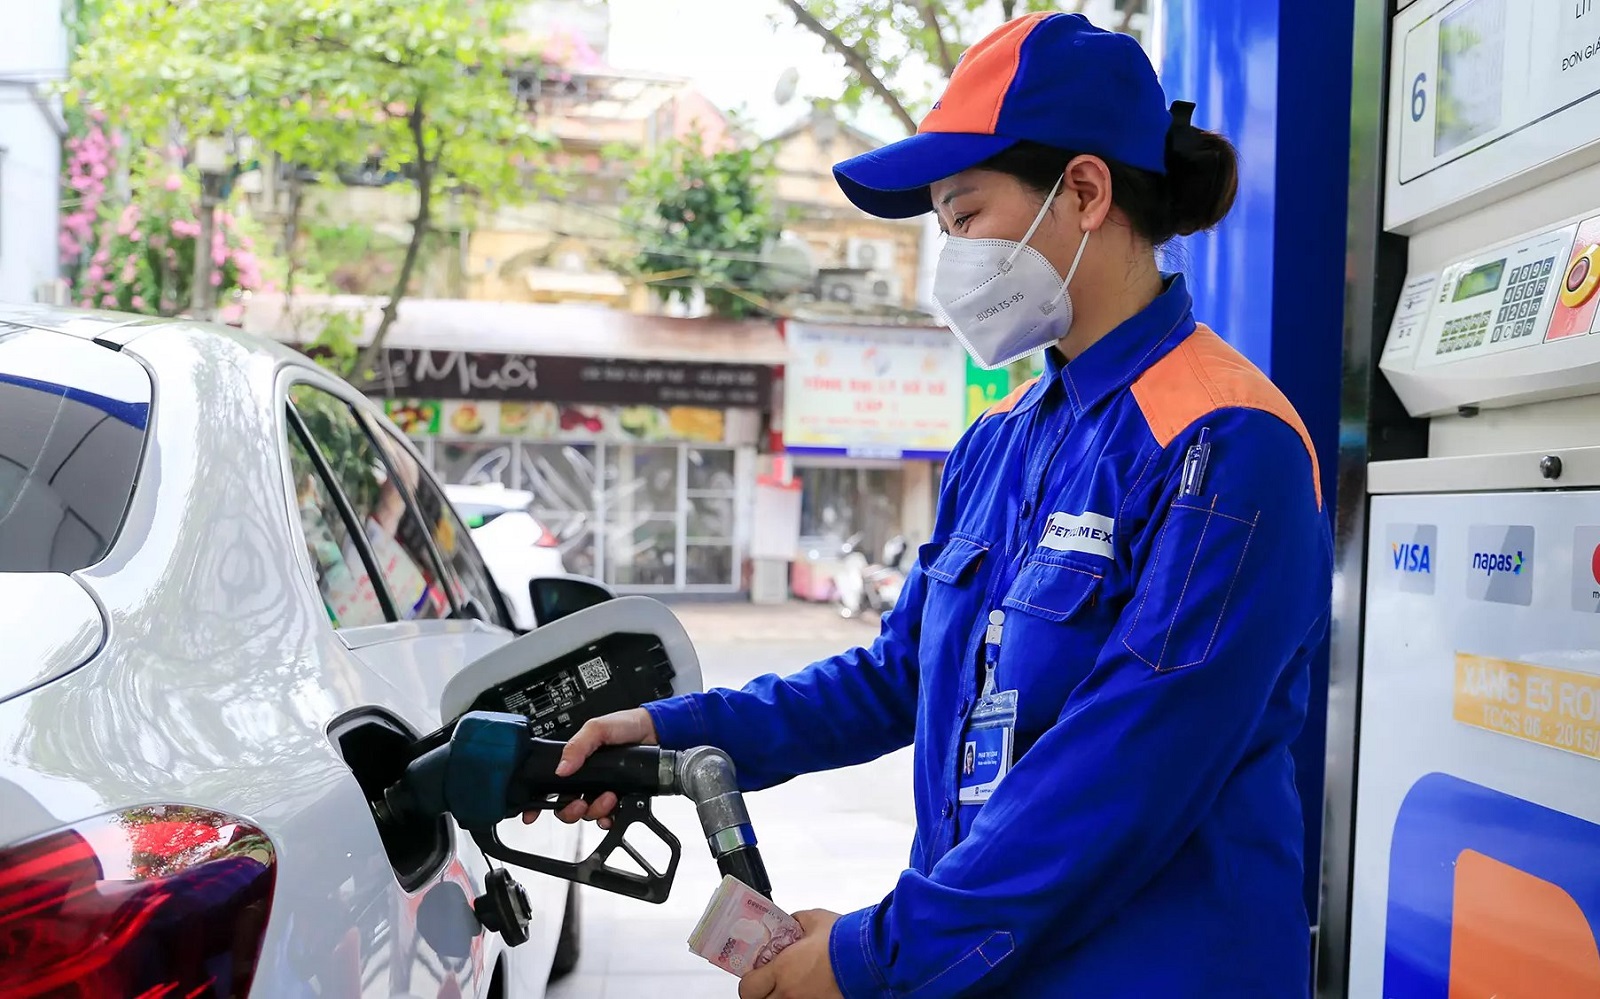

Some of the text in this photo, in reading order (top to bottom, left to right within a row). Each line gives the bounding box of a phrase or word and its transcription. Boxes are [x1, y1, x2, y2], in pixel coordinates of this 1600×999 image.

[1411, 72, 1427, 123] 6
[976, 305, 999, 322] BUSH
[1048, 524, 1113, 544] PETMEX
[1392, 542, 1431, 574] VISA
[1473, 552, 1513, 576] napas
[1526, 675, 1554, 712] E5
[544, 720, 555, 731] 95
[1482, 704, 1521, 733] TCCS
[1525, 715, 1542, 738] 06
